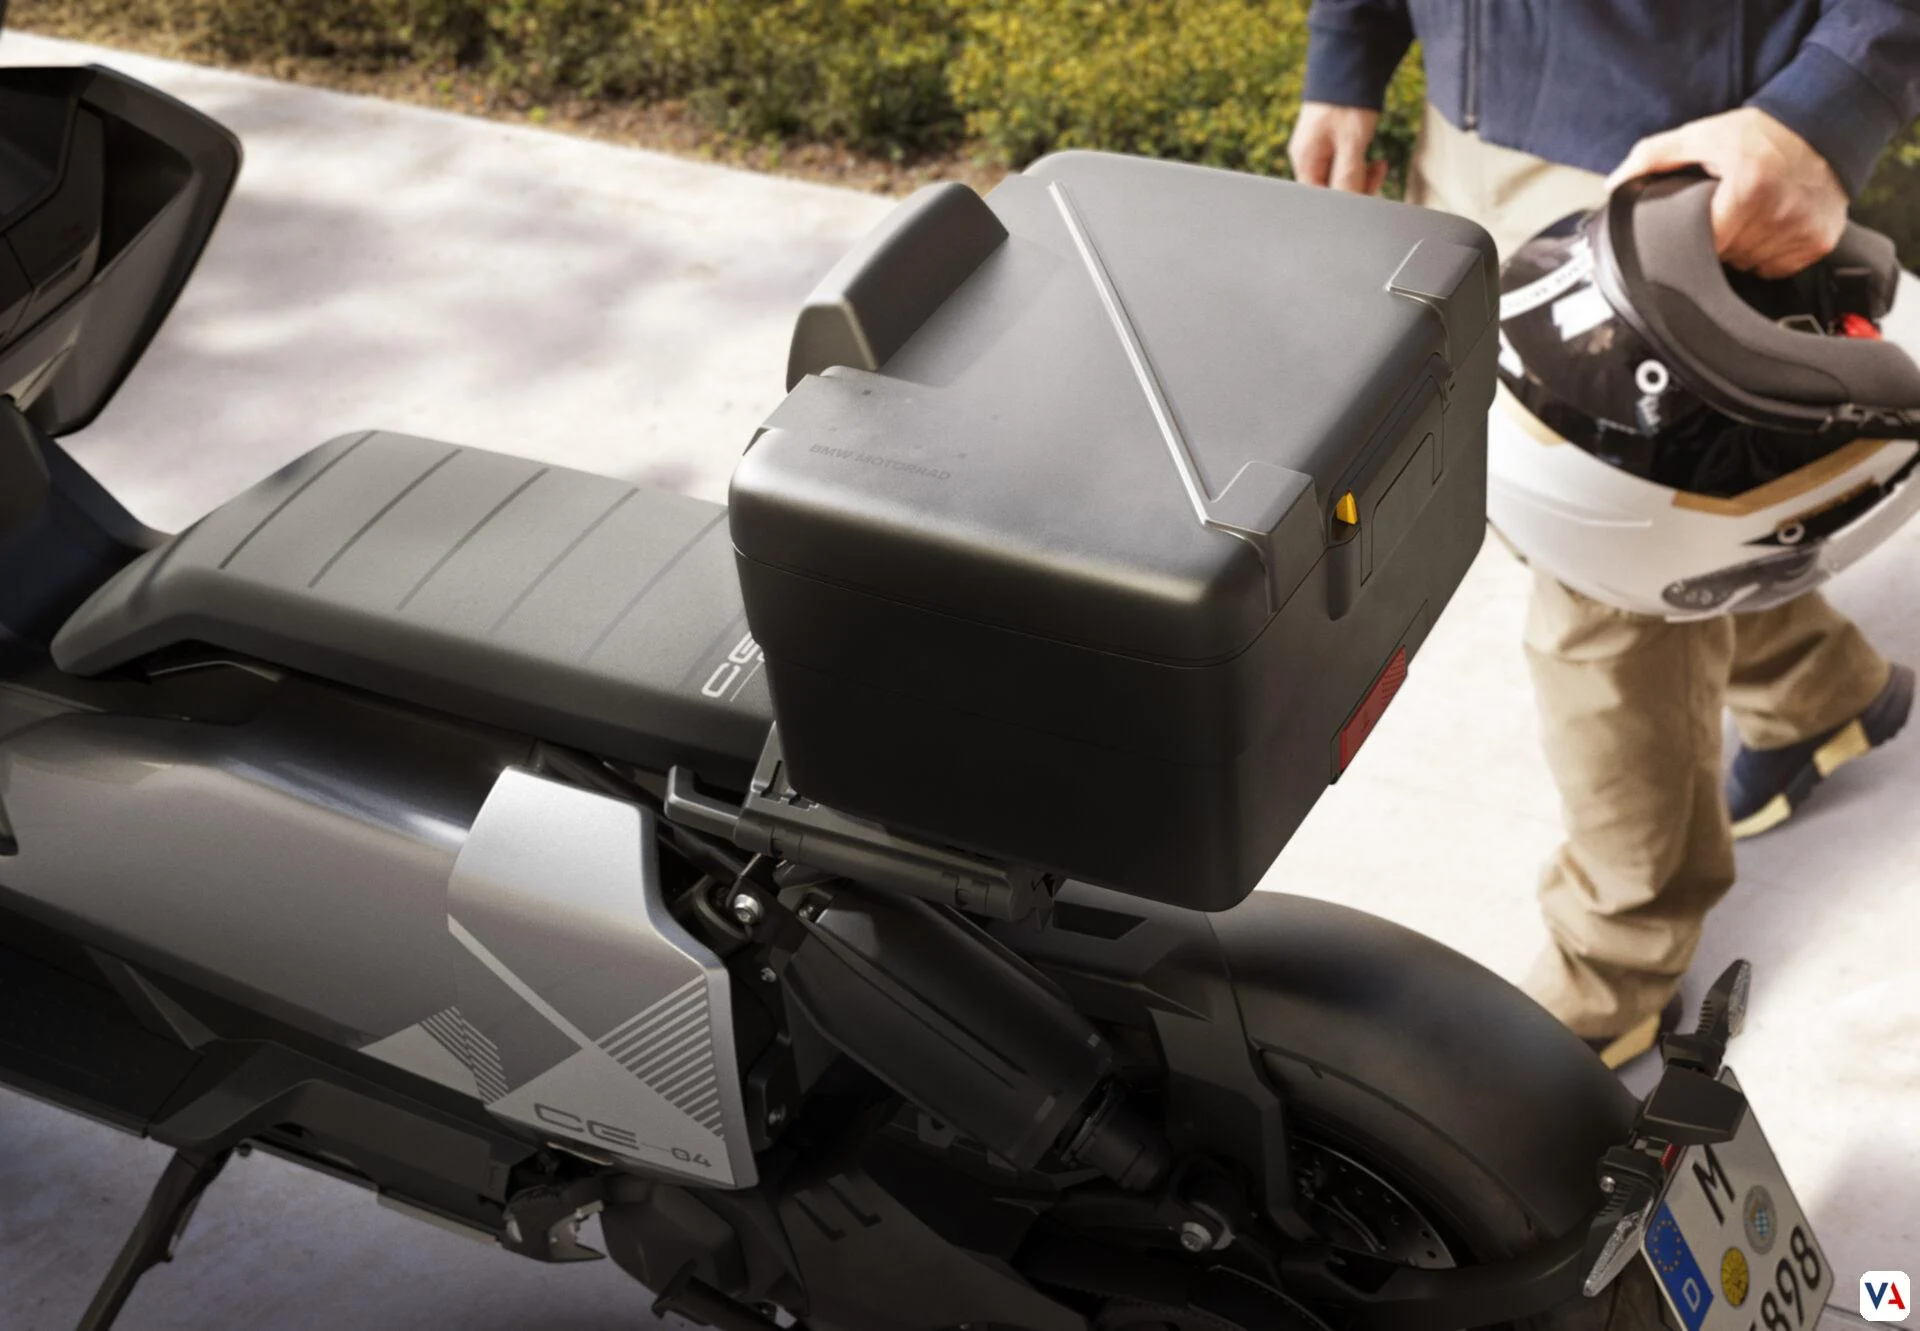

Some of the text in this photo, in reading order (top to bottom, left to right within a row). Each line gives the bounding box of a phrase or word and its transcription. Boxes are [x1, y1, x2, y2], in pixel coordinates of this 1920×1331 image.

[809, 443, 951, 481] BMW MOTORRAD
[671, 1146, 713, 1168] 04
[1692, 1144, 1735, 1226] M
